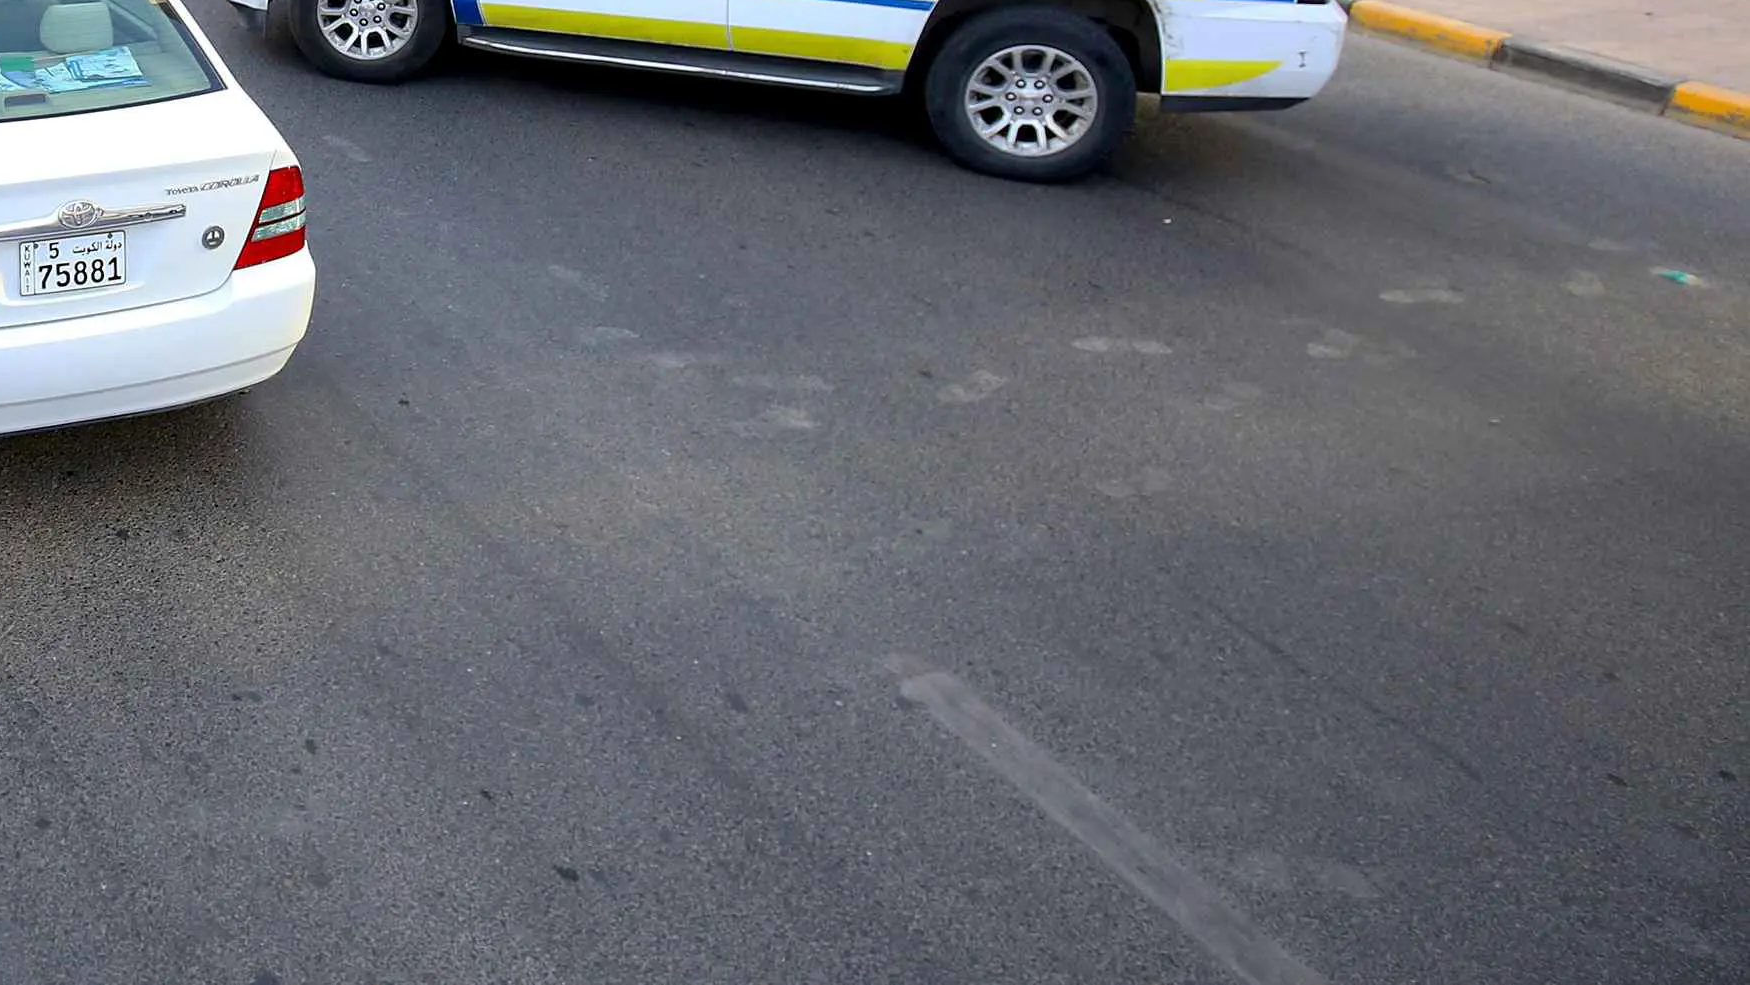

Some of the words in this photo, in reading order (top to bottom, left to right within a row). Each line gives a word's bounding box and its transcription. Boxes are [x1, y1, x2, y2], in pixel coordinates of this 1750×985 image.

[48, 242, 60, 259] 5
[72, 241, 103, 256] الكويت
[23, 244, 31, 293] KUWAIT
[38, 256, 122, 290] 75881
